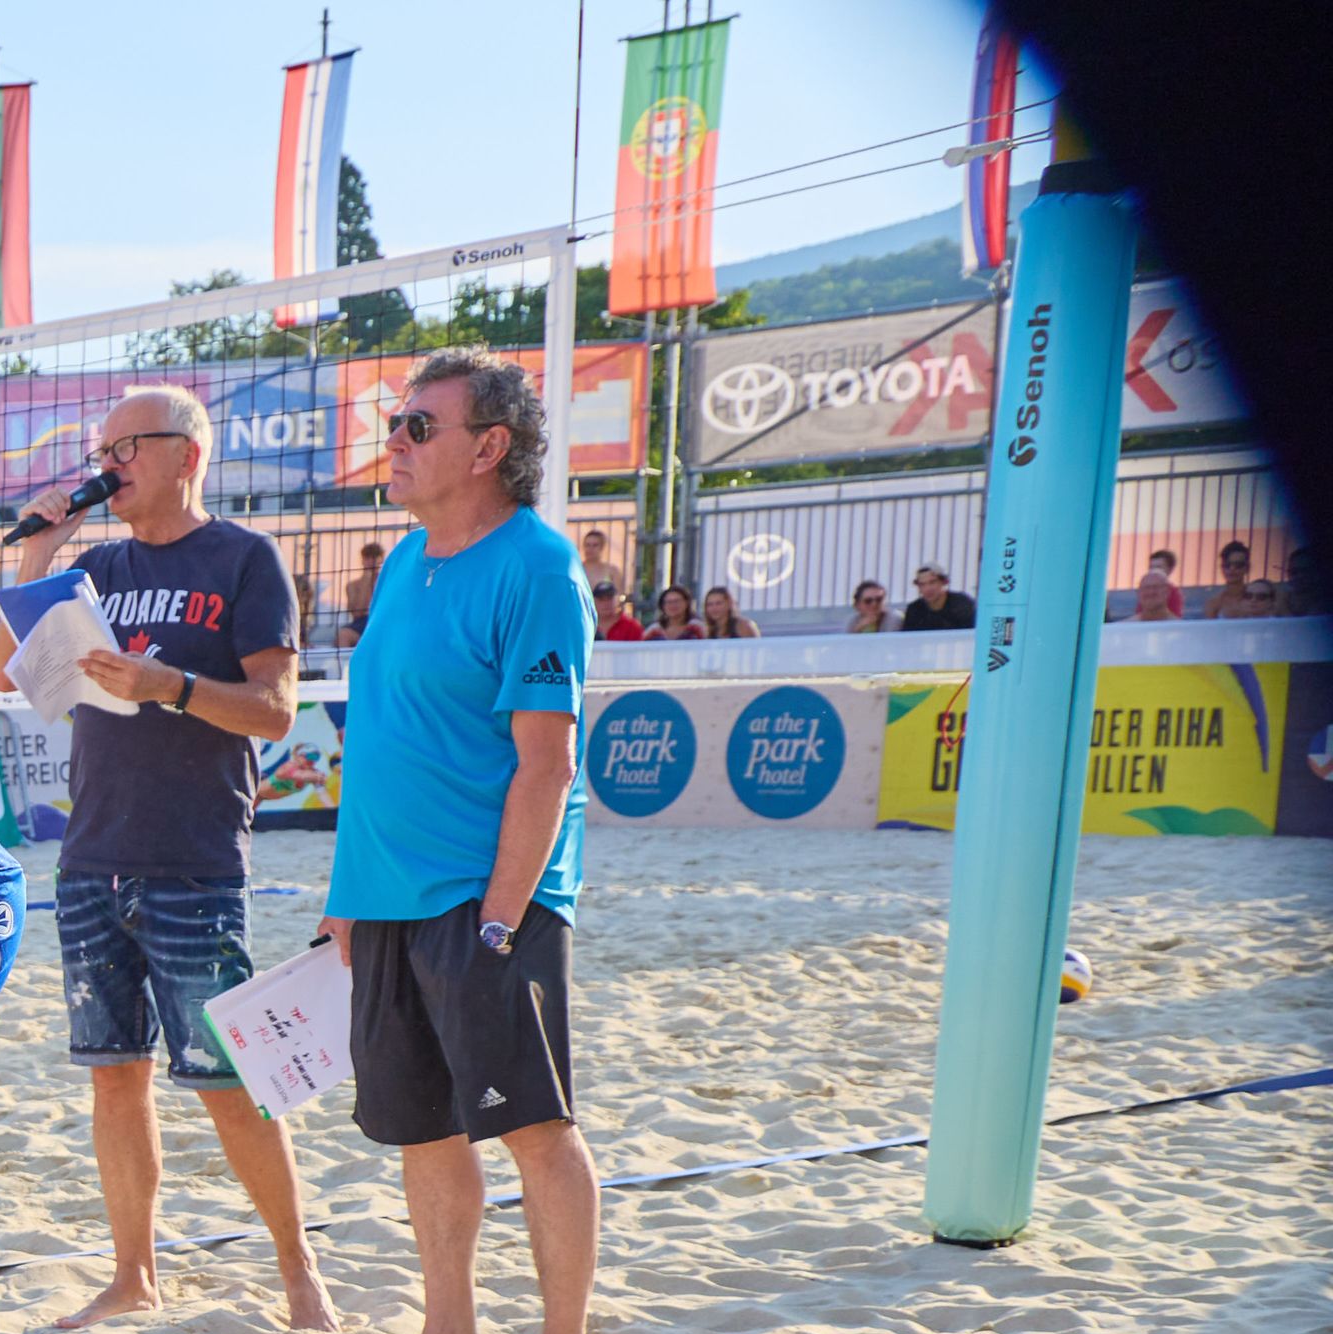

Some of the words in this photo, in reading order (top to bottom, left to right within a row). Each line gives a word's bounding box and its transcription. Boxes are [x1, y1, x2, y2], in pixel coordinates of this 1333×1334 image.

[468, 242, 524, 264] Senoh
[803, 355, 976, 411] TOYOTA
[1016, 303, 1052, 431] Senoh
[233, 406, 326, 450] NOE
[1003, 536, 1018, 570] CEV
[522, 672, 572, 686] adidas
[607, 719, 627, 735] at
[630, 714, 659, 735] the
[748, 717, 768, 733] at
[774, 712, 804, 733] the
[1154, 707, 1224, 747] RIHA
[602, 721, 677, 778] park
[744, 719, 824, 778] park
[615, 764, 661, 785] hotel
[758, 764, 807, 785] hotel
